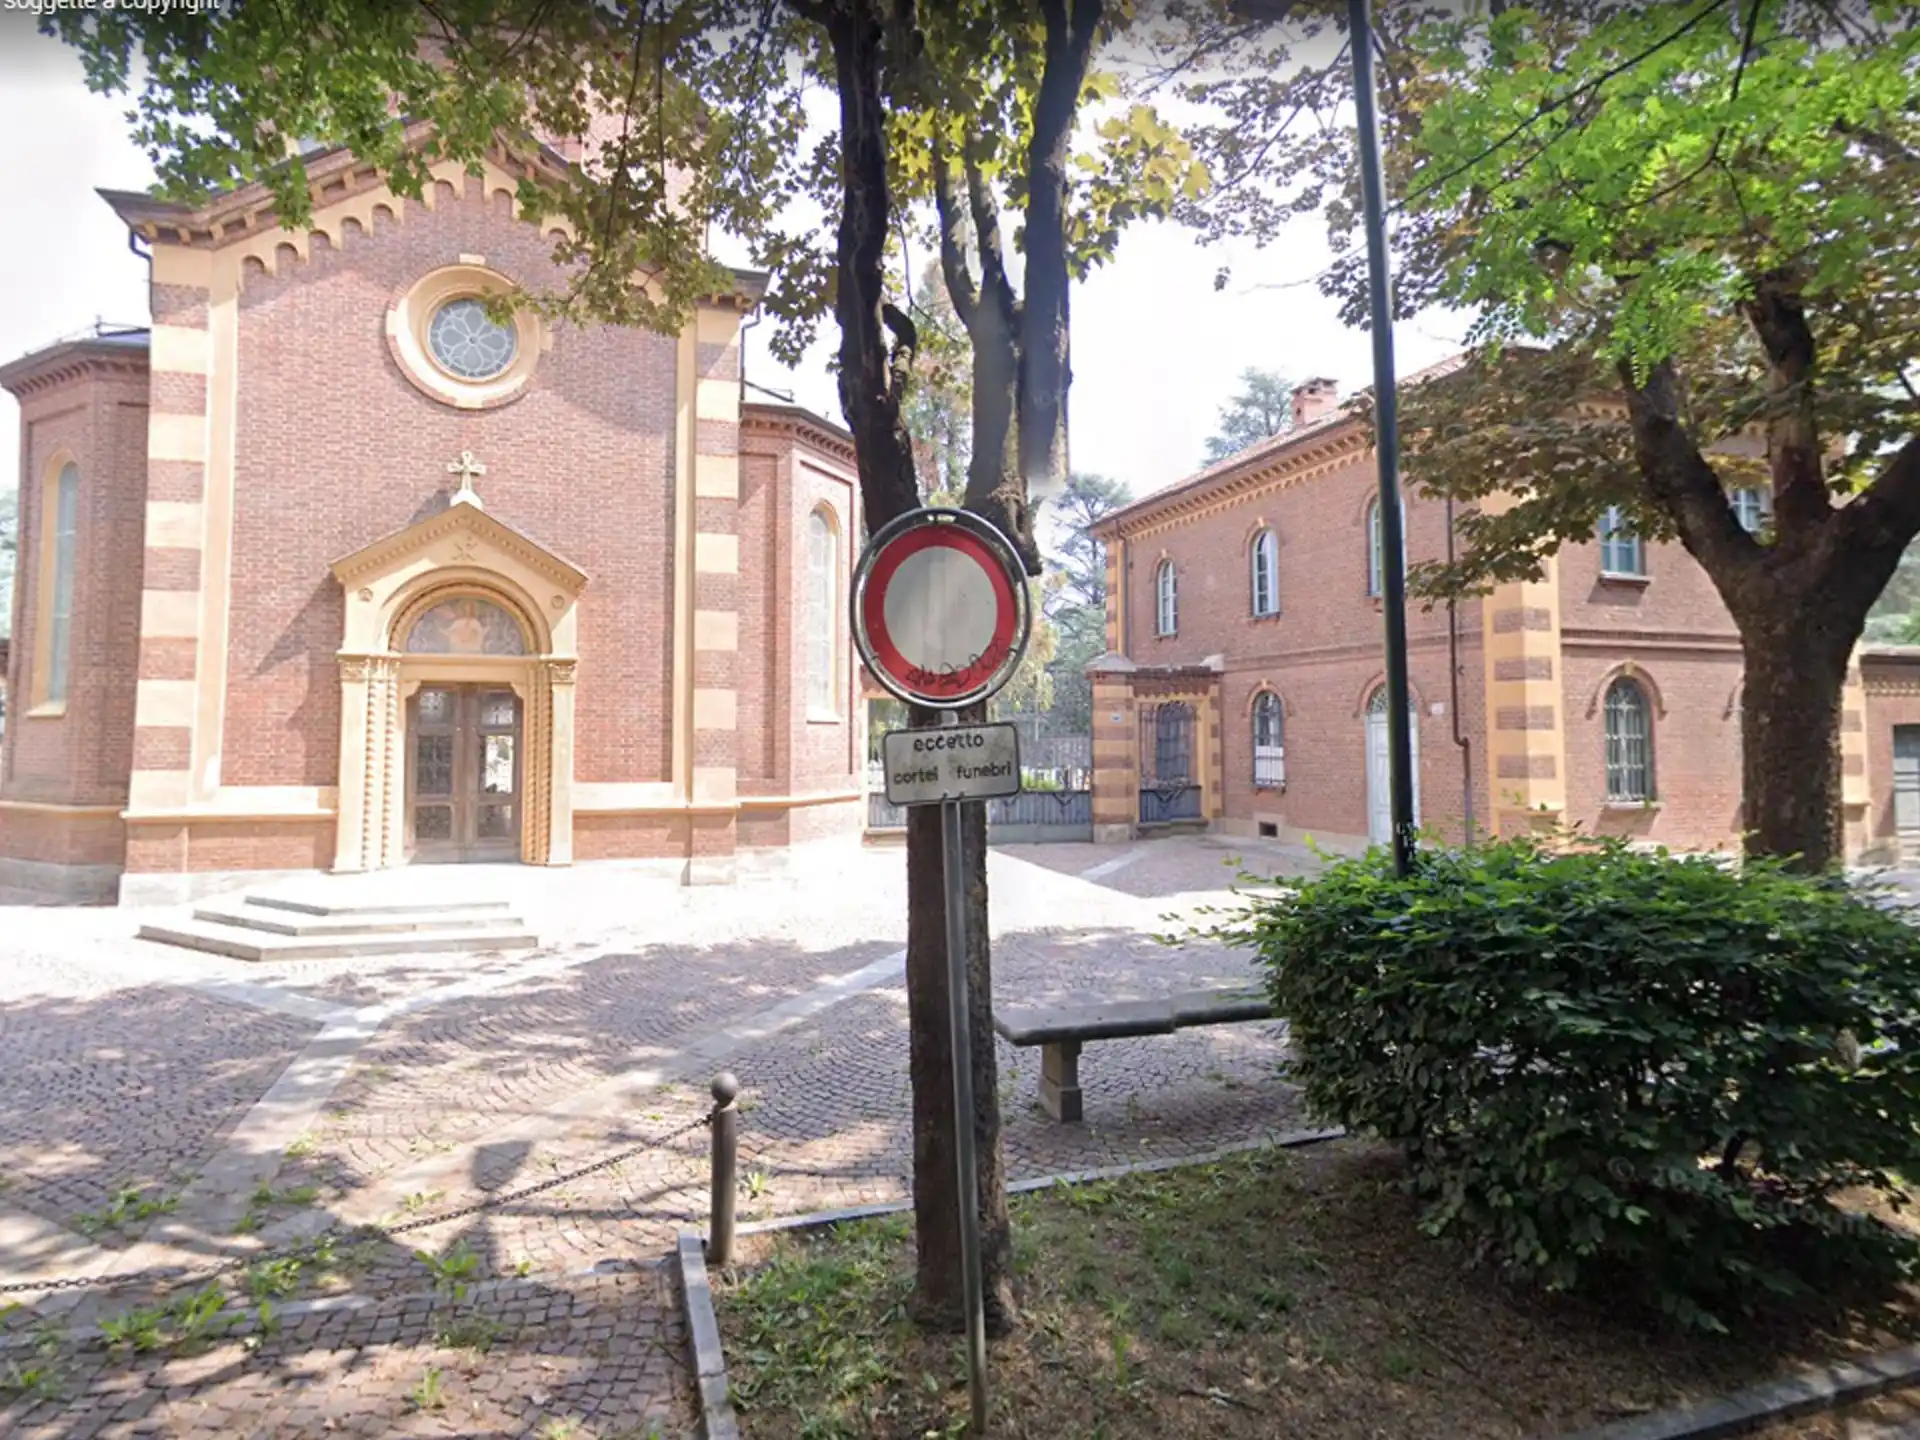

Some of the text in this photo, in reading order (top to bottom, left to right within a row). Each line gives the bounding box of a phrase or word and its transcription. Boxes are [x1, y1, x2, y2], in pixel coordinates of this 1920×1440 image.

[913, 733, 984, 752] eccetto
[893, 761, 1012, 785] cortei funebri
